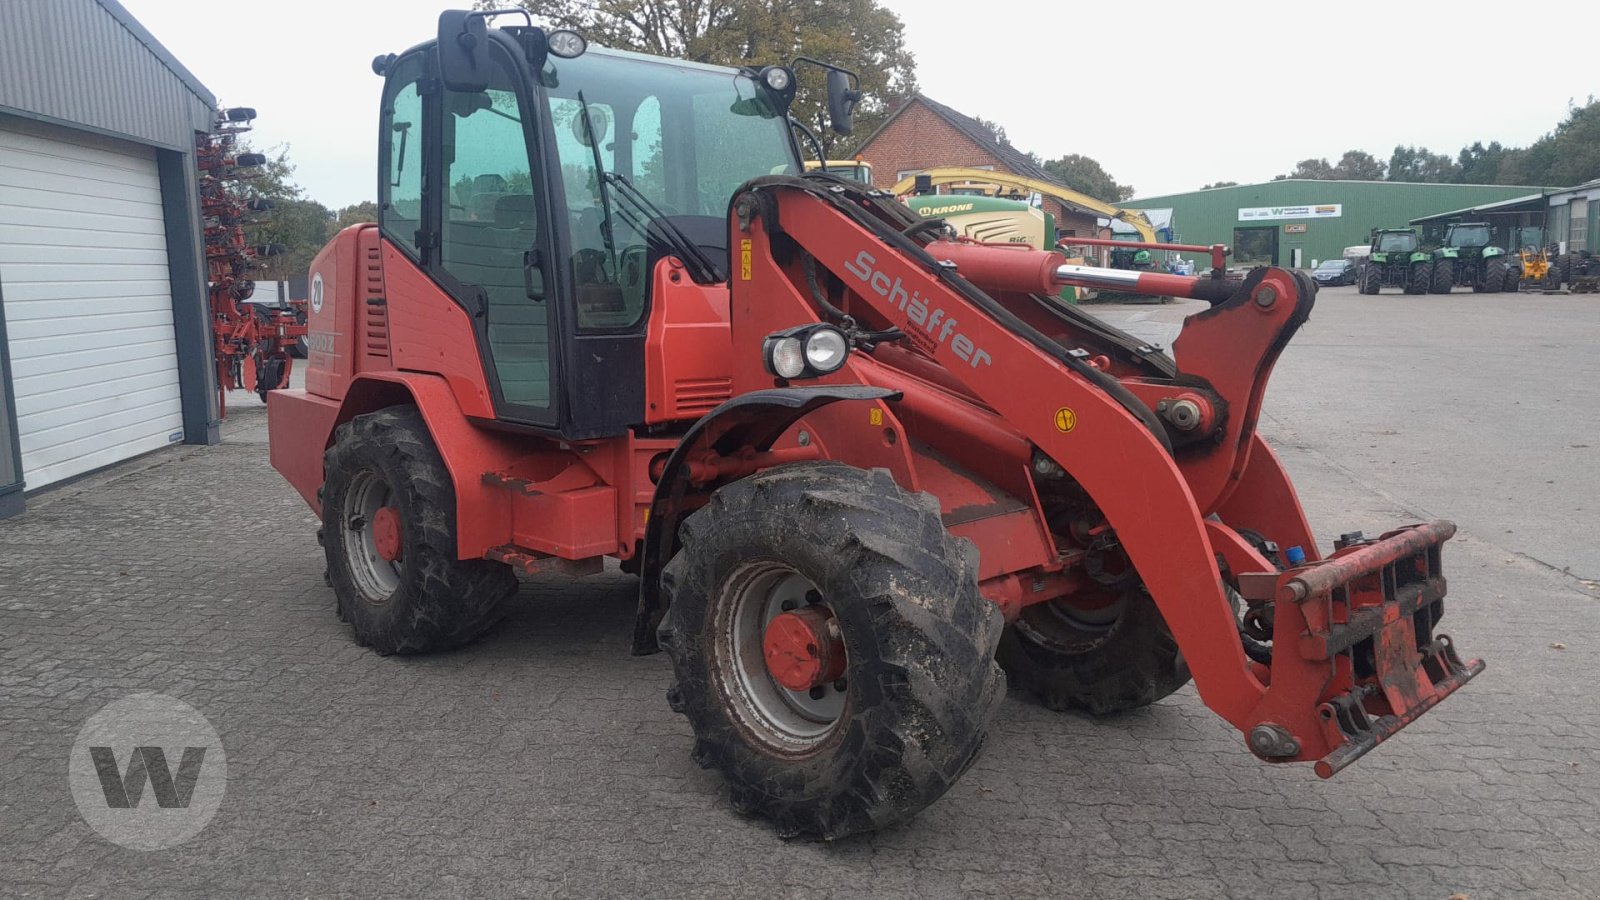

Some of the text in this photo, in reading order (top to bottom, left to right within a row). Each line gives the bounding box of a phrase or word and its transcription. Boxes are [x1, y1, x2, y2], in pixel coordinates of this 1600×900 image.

[932, 203, 974, 215] KRONE
[313, 280, 321, 306] 20
[844, 250, 992, 368] Schäffer
